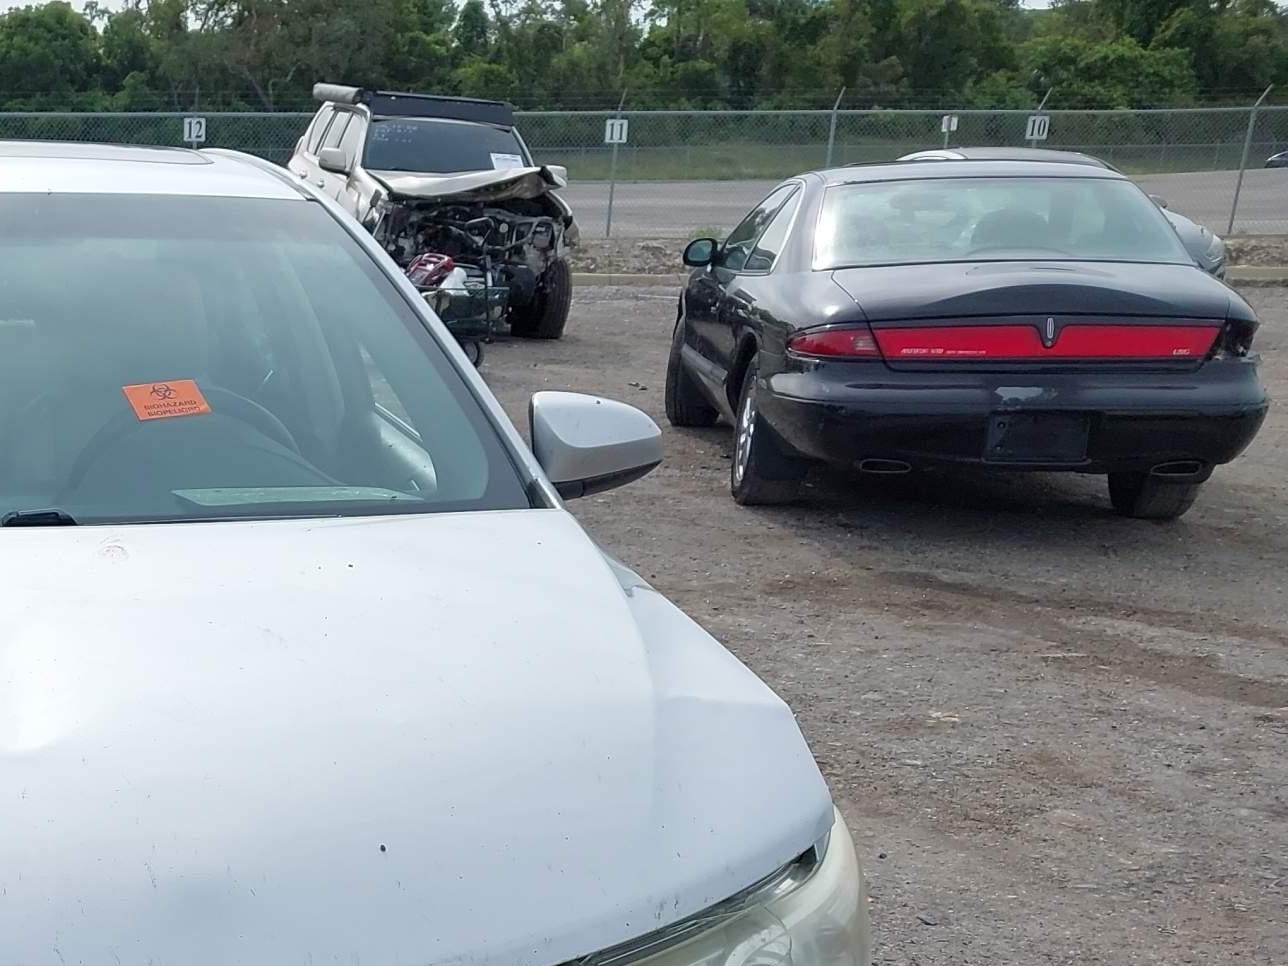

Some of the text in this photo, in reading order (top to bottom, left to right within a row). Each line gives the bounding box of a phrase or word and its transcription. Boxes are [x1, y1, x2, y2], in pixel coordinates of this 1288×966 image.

[187, 120, 203, 139] 12
[609, 122, 624, 141] 11
[1029, 119, 1047, 137] 10
[143, 399, 197, 410] BIOHAZARD
